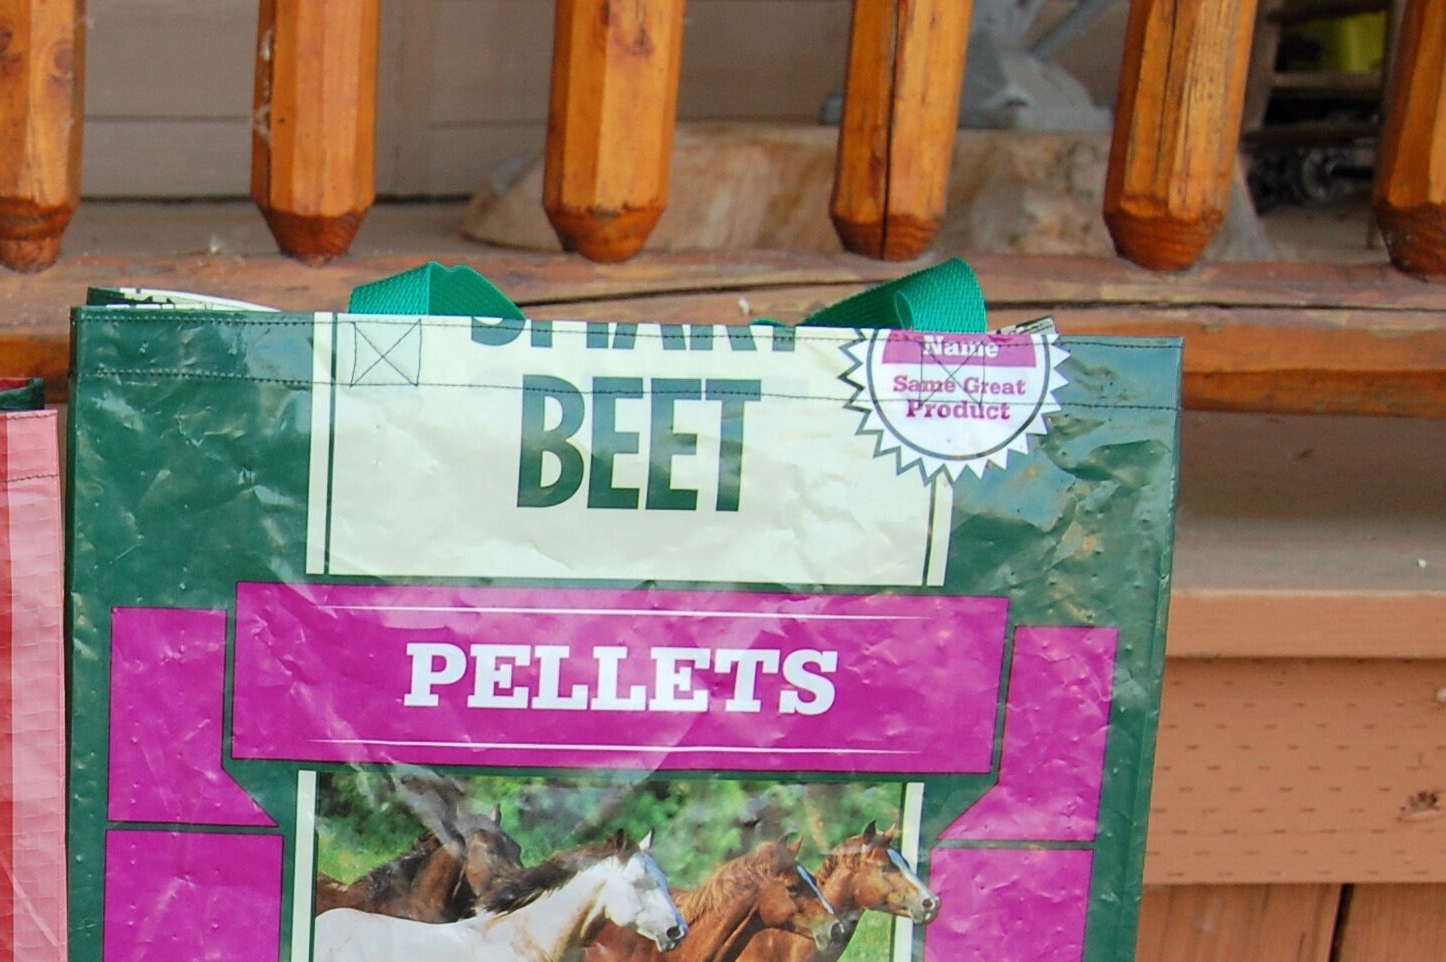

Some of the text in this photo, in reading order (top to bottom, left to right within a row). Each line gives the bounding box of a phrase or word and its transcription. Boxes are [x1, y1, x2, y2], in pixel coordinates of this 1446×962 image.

[922, 335, 1000, 358] Name
[893, 375, 1026, 396] Same Great
[906, 399, 1011, 420] Product
[516, 373, 762, 512] BEET
[403, 642, 838, 715] PELLETS
